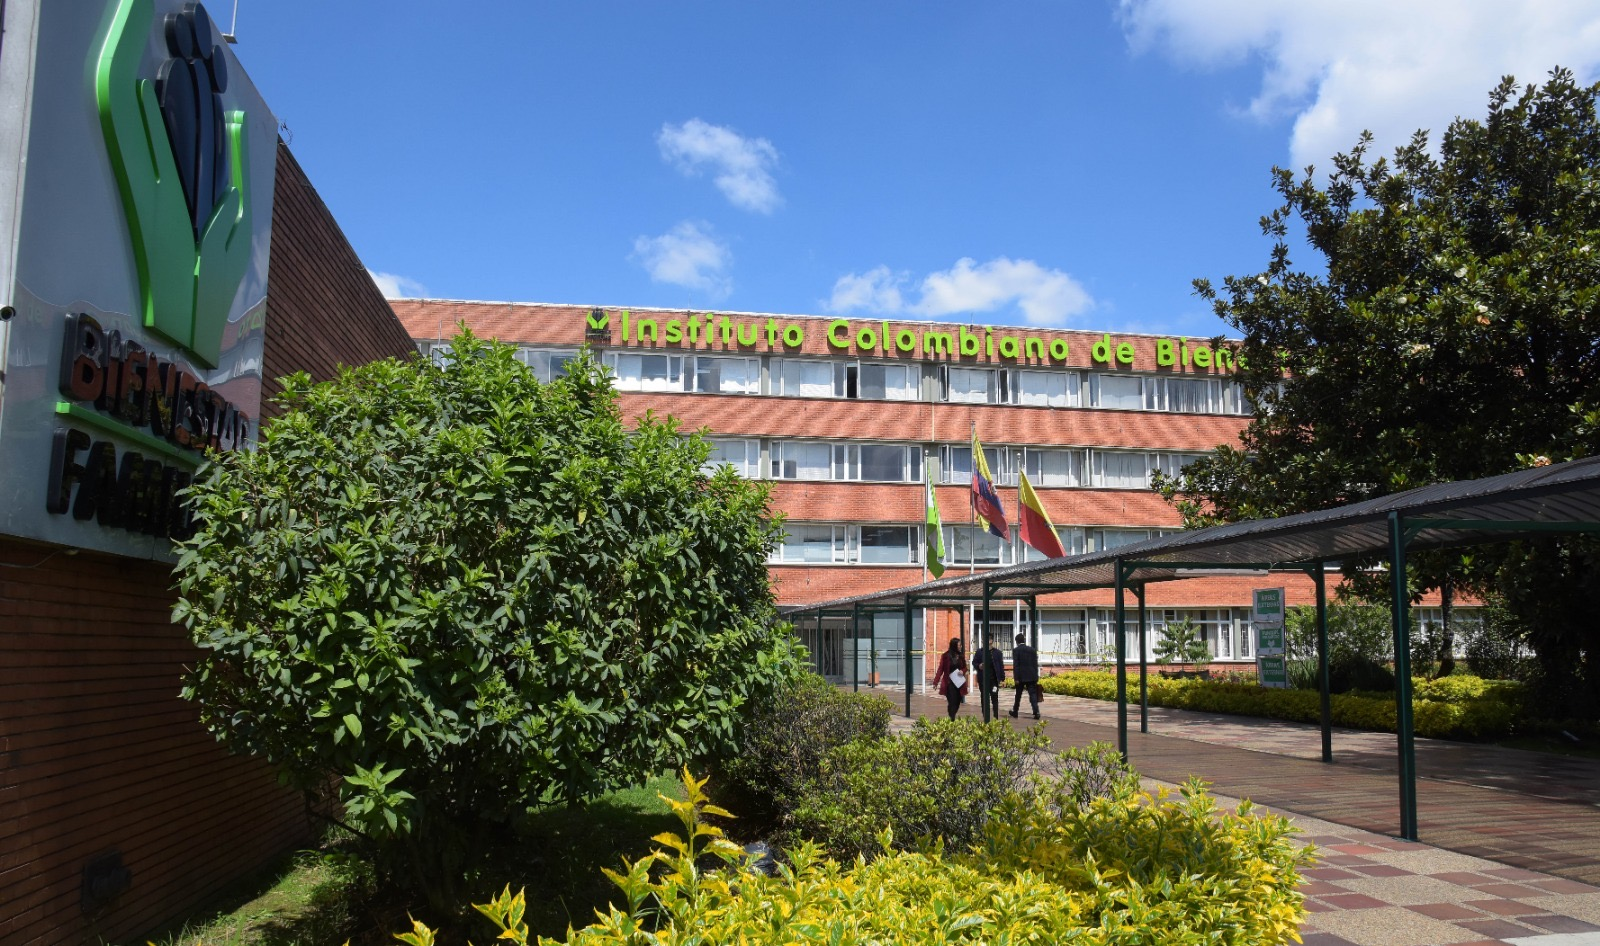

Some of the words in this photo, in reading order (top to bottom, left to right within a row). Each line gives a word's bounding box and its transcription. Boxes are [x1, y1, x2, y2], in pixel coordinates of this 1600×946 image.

[622, 310, 804, 348] Instituto
[827, 319, 1069, 361] Colombiano
[1091, 333, 1135, 365] de
